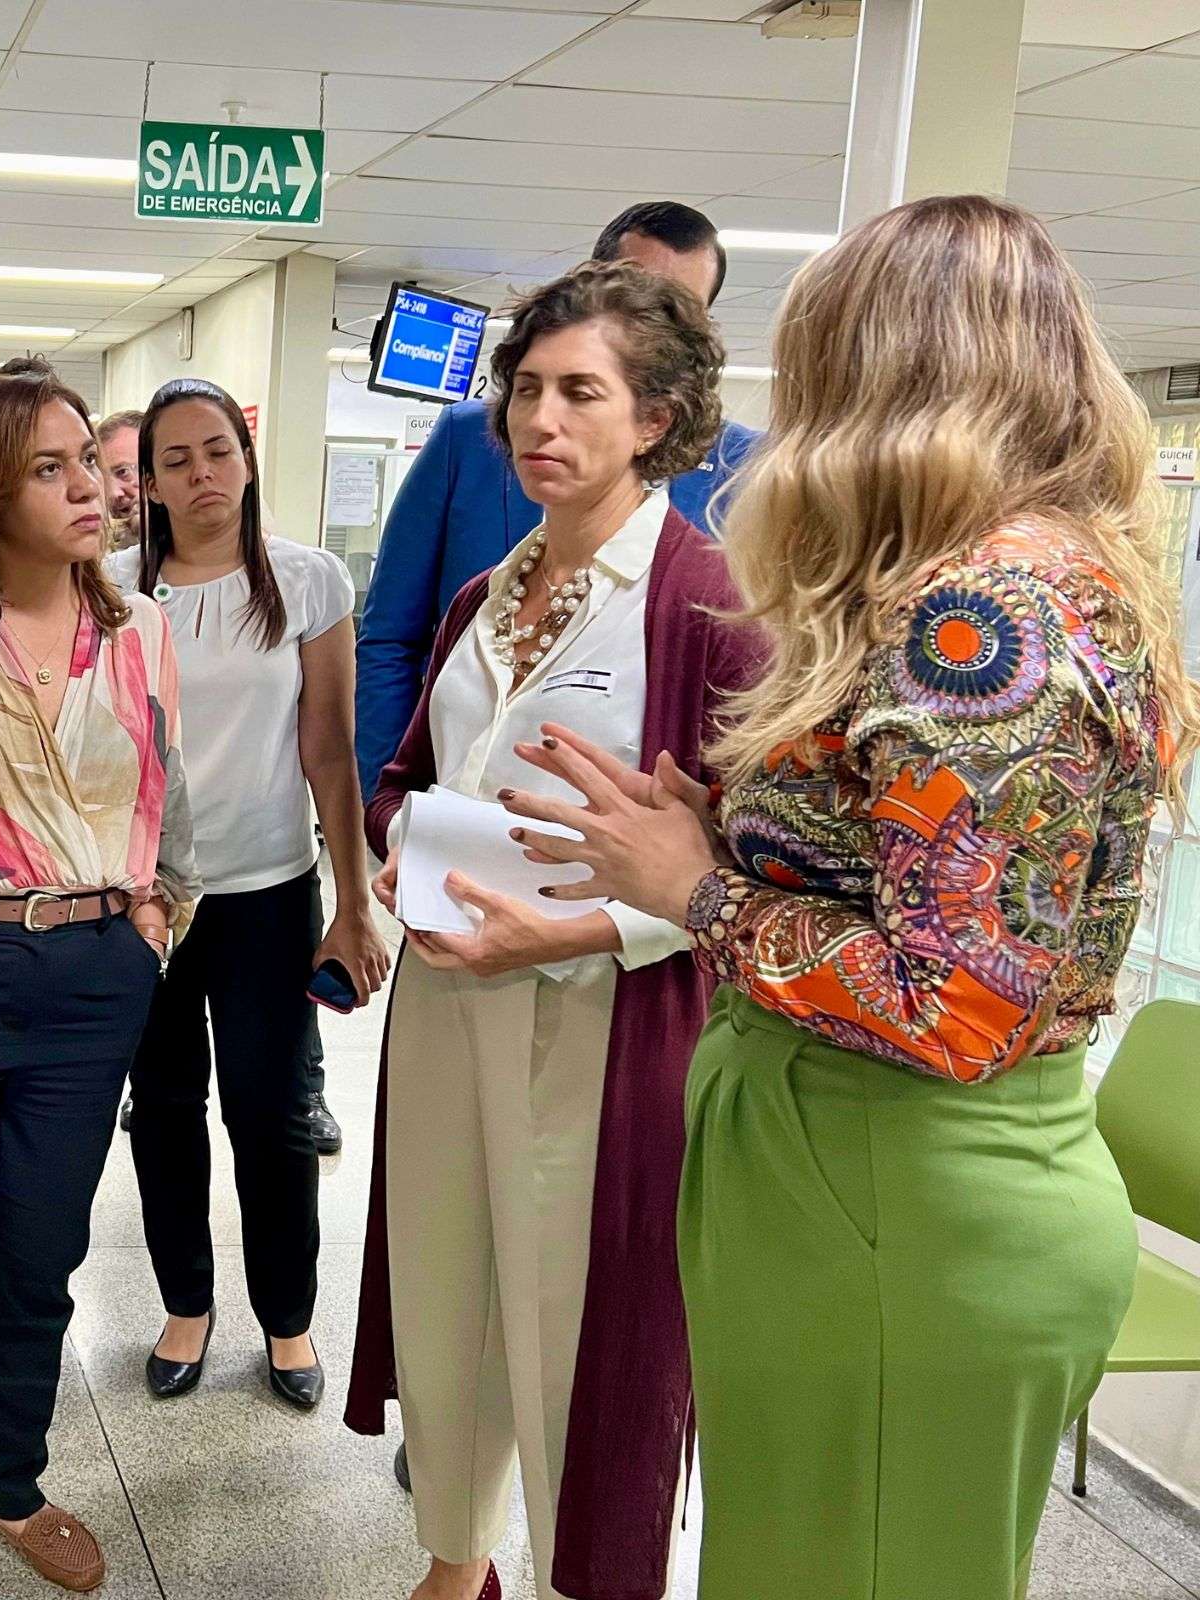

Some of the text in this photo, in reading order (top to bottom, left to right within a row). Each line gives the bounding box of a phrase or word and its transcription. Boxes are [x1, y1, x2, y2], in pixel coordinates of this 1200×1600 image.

[144, 131, 281, 195] SAÍDA
[143, 195, 282, 216] DE EMERGÊNCIA
[392, 339, 446, 363] Compliance
[473, 375, 488, 399] 2
[410, 419, 434, 429] GUIC
[1171, 464, 1178, 473] 4
